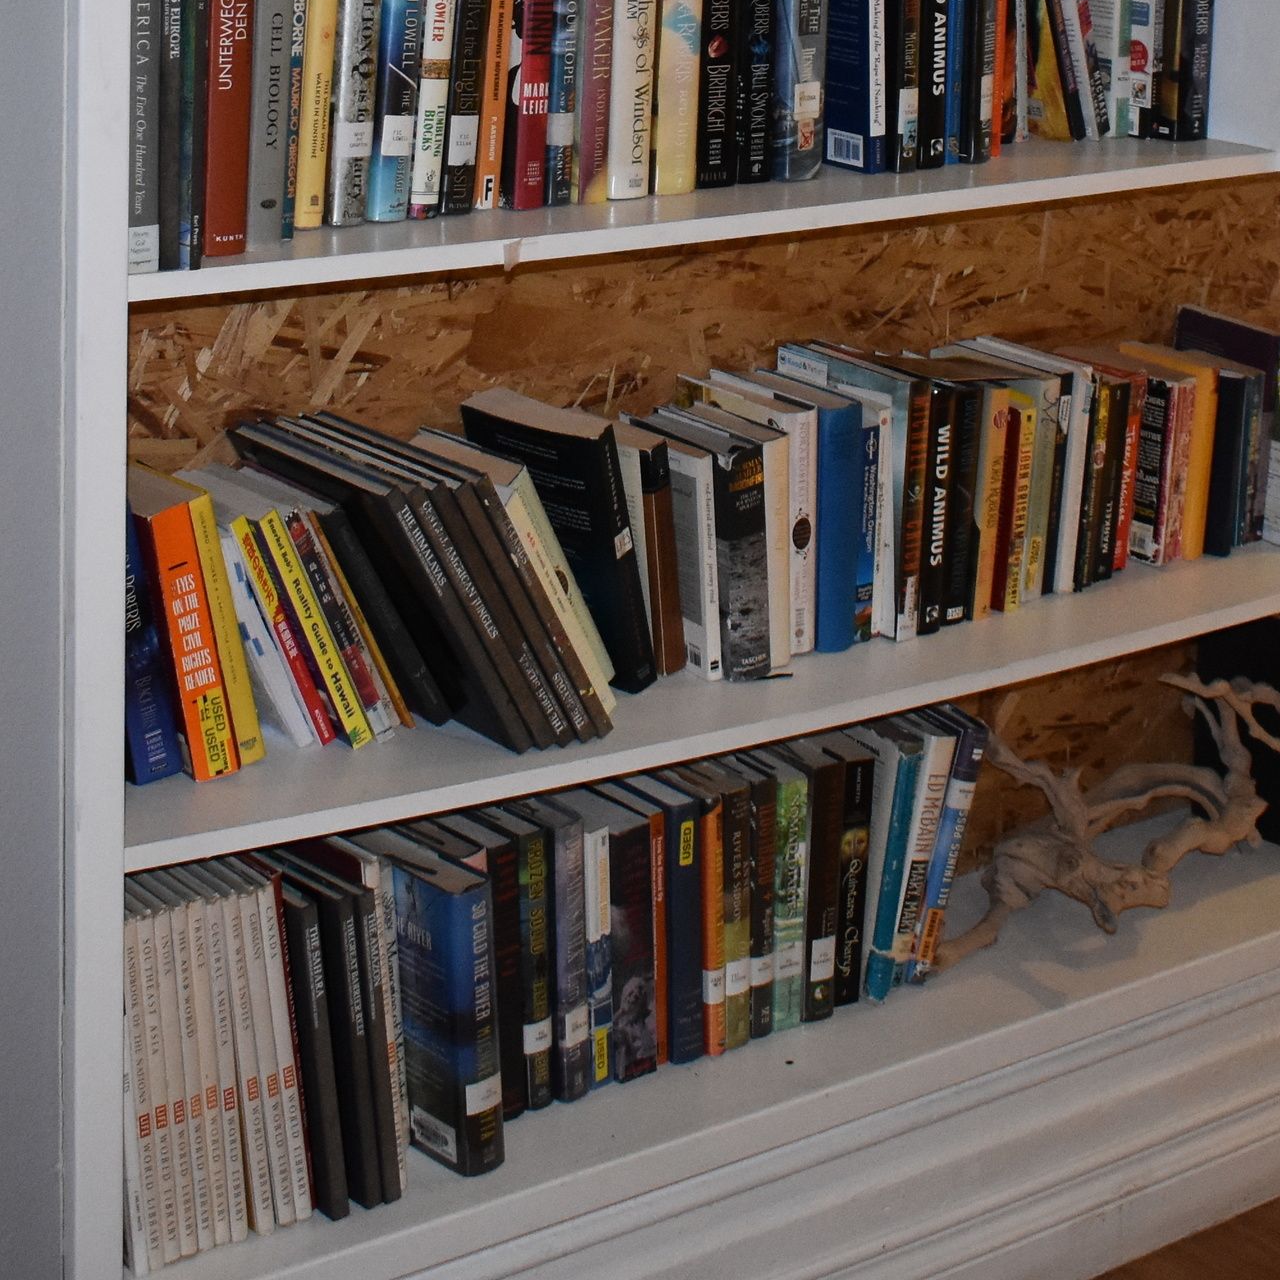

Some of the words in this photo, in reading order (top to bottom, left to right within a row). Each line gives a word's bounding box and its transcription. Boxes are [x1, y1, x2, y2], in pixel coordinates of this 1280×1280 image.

[234, 8, 248, 41] DEN
[271, 12, 284, 57] CELL
[402, 9, 417, 69] LOWELL
[808, 9, 820, 33] THE
[564, 38, 576, 84] HOPE
[635, 52, 650, 79] of
[931, 13, 948, 97] ANIMUS
[136, 75, 147, 94] The
[136, 96, 146, 117] First
[266, 66, 280, 150] BIOLOGY
[629, 83, 651, 166] Windsor
[136, 119, 147, 140] One
[421, 110, 436, 152] BLOCKS
[433, 105, 445, 157] TUMBLING
[136, 144, 147, 186] Hundred
[135, 189, 146, 215] Years
[935, 425, 951, 479] WILD
[400, 503, 415, 523] THE
[410, 521, 447, 586] HIMALAYAS
[929, 487, 947, 568] ANIMUS
[173, 599, 183, 615] ON
[184, 593, 200, 610] THE
[443, 540, 475, 600] AMERICAN
[470, 597, 499, 640] JUNGLES
[178, 616, 201, 634] PRIZE
[267, 517, 285, 552] Snorkel
[281, 552, 293, 574] Bob's
[292, 579, 313, 620] Reality
[311, 622, 328, 657] Guide
[326, 658, 334, 671] to
[330, 671, 355, 719] Hawaii
[182, 631, 202, 652] CIVIL
[182, 649, 211, 672] RIGHTS
[184, 667, 216, 692] READER
[210, 696, 226, 732] USED
[204, 727, 221, 763] USED
[682, 827, 692, 862] USED
[471, 900, 486, 920] SO
[193, 917, 204, 969] FRANCE
[266, 906, 277, 960] CANADA
[472, 920, 488, 955] COLD
[473, 956, 490, 981] THE
[475, 982, 491, 1020] RIVER
[596, 1036, 608, 1070] USED
[141, 1114, 150, 1136] LIFE
[157, 1106, 166, 1128] LIFE
[143, 1145, 153, 1190] WORLD
[160, 1135, 170, 1182] WORLD
[178, 1130, 188, 1177] WORLD
[194, 1125, 204, 1170] WORLD
[147, 1199, 160, 1250] LIBRARY
[164, 1189, 176, 1241] LIBRARY
[182, 1184, 194, 1237] LIBRARY
[198, 1177, 209, 1231] LIBRARY
